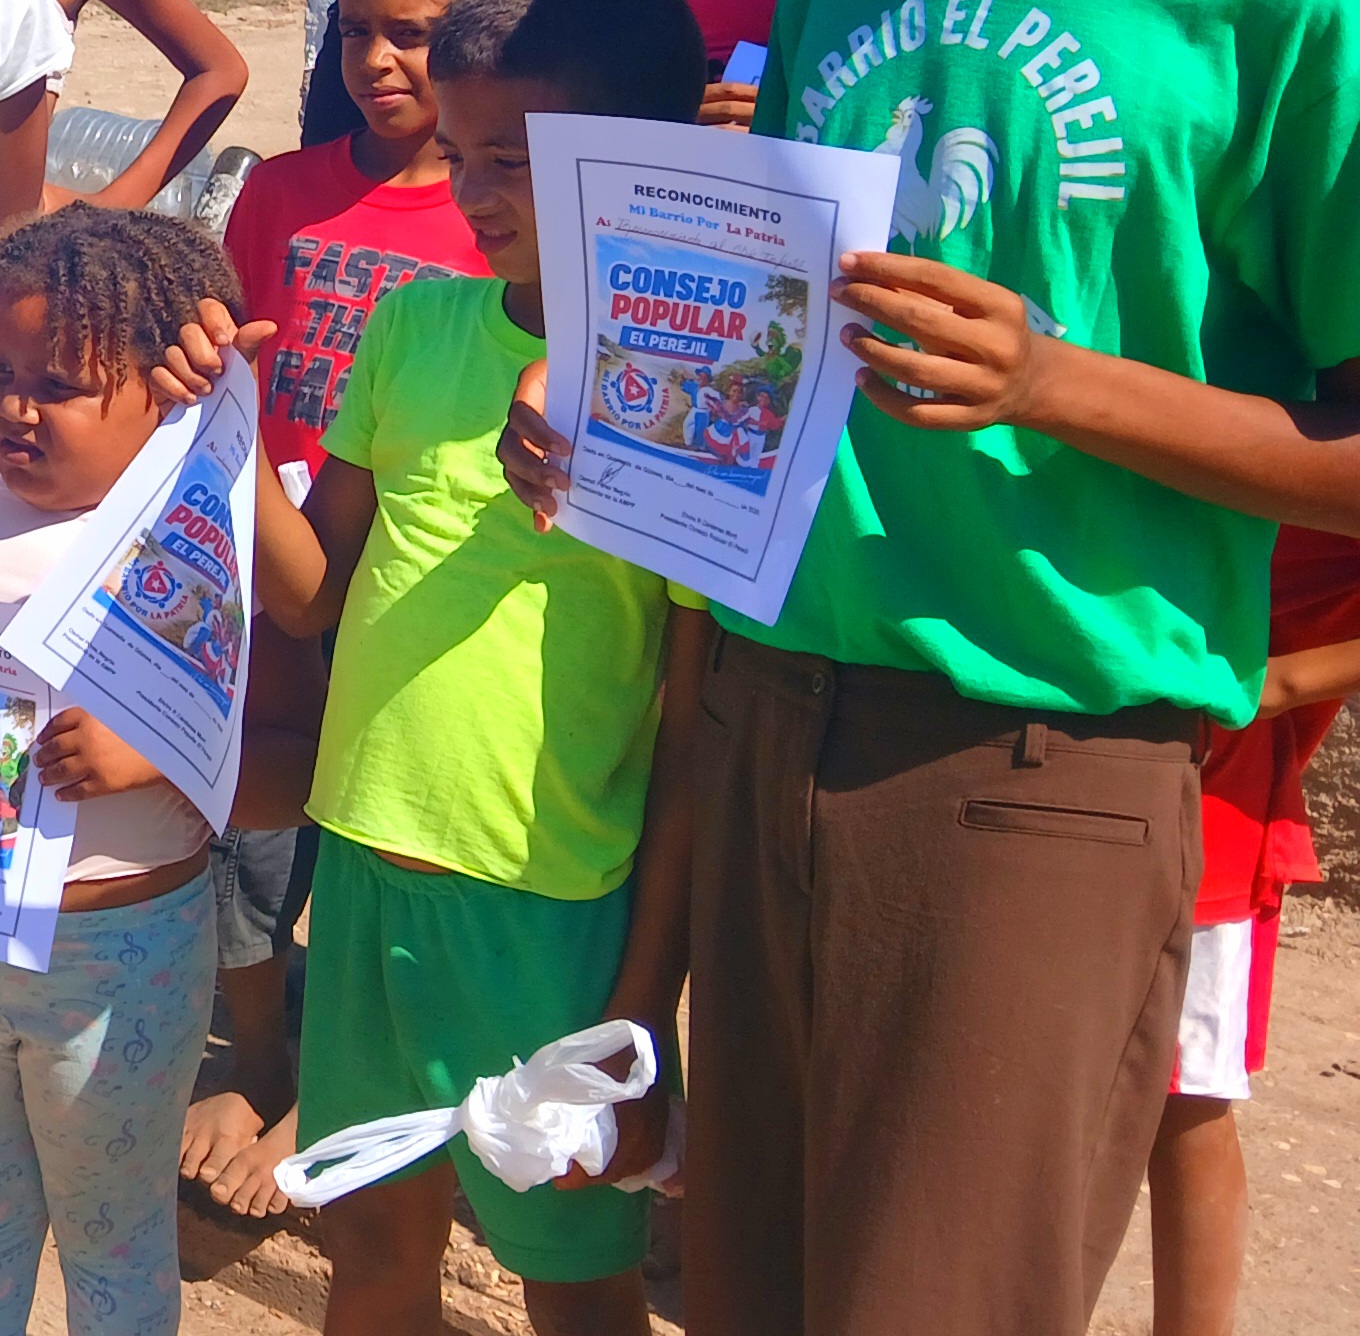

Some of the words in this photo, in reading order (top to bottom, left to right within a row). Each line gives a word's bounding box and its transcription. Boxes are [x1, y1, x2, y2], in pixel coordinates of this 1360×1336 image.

[997, 8, 1125, 210] PEREJIL
[633, 183, 783, 225] RECONOCIMIENTO
[629, 204, 646, 215] Mi
[649, 207, 693, 225] Barrio
[696, 216, 720, 231] Por
[726, 222, 742, 235] La
[745, 227, 786, 247] Patria
[609, 263, 748, 309] CONSEJO
[610, 293, 748, 341] POPULAR
[630, 331, 646, 346] EL
[648, 334, 709, 357] PEREJIL
[621, 418, 641, 431] POR
[643, 419, 655, 431] LA
[171, 538, 187, 557] EL
[130, 601, 148, 617] POR
[150, 612, 162, 620] LA
[164, 595, 189, 619] PATRIA
